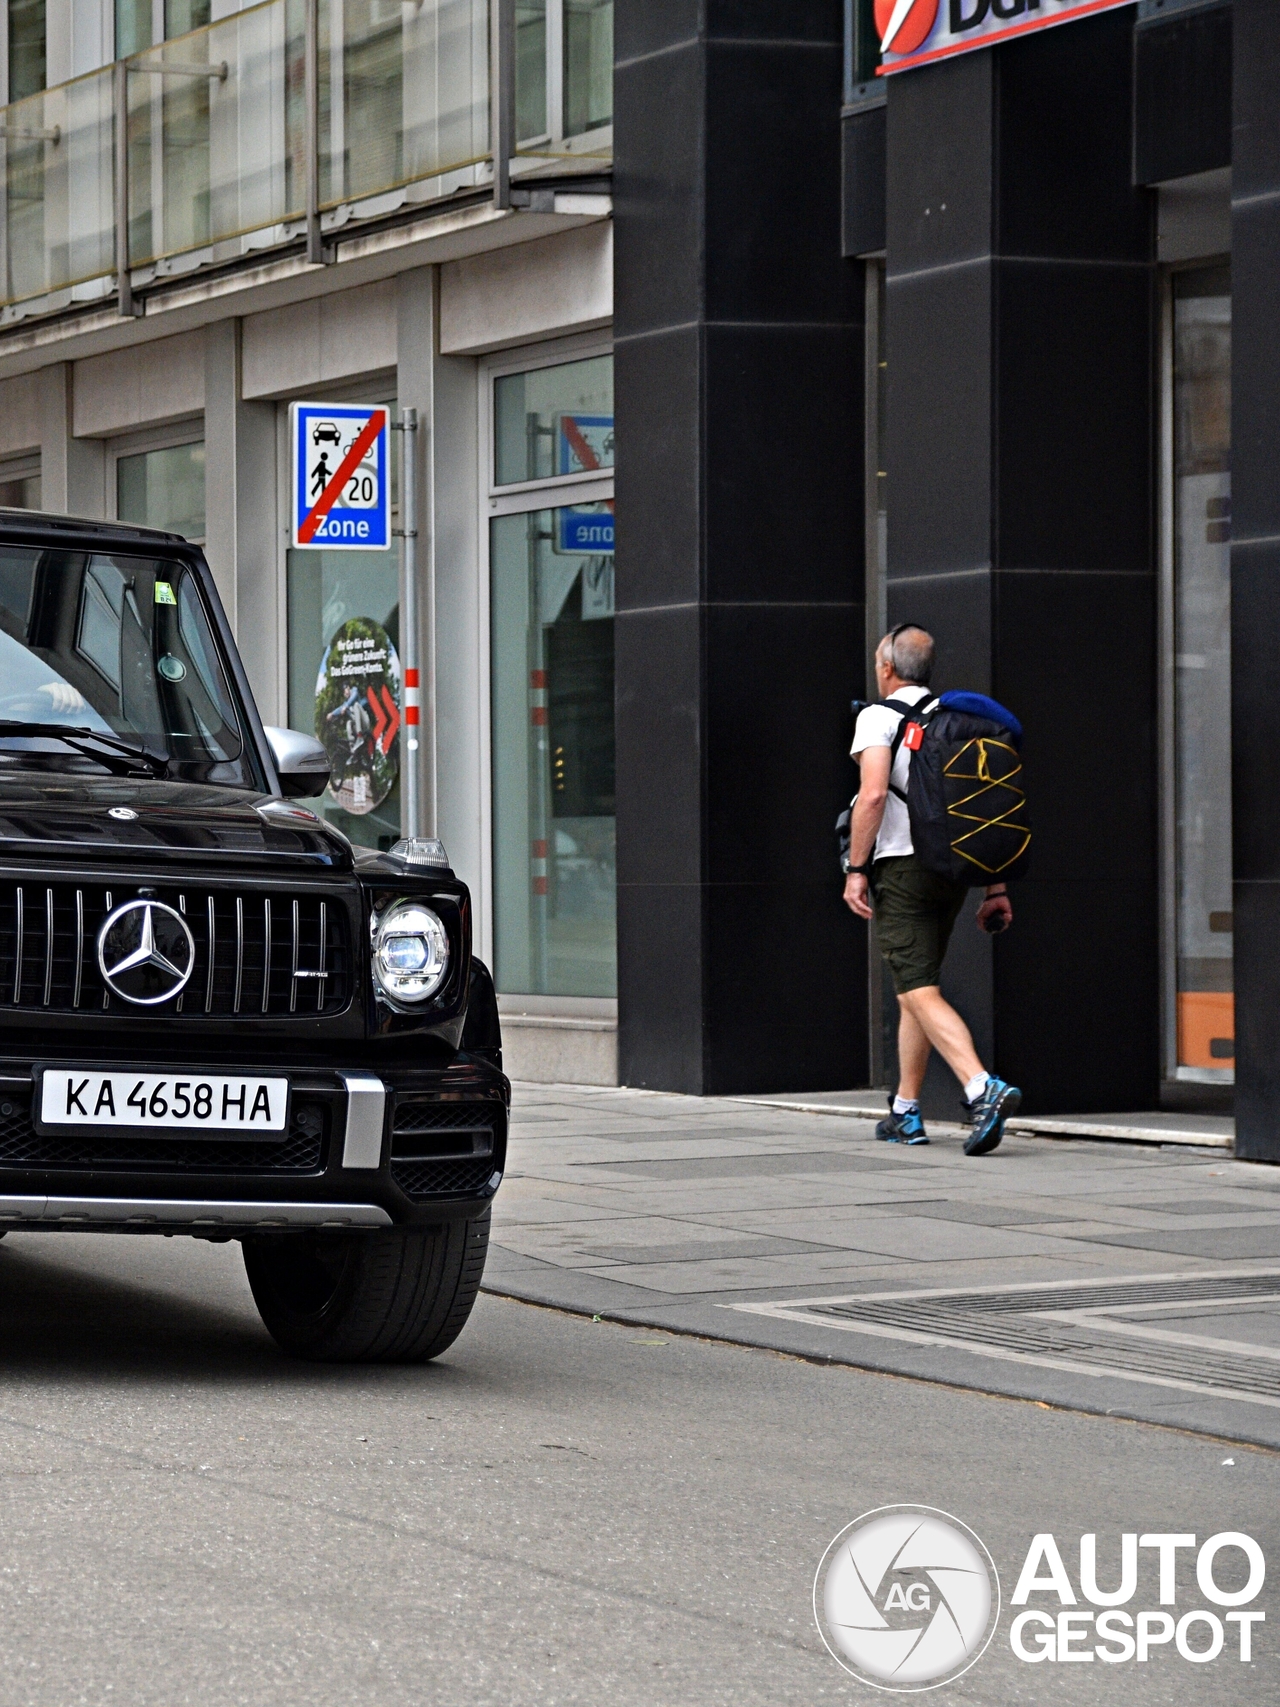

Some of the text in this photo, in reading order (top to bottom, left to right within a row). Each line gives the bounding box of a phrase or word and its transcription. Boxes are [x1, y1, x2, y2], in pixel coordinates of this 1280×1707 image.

[349, 477, 373, 501] 20
[315, 515, 370, 538] Zone
[66, 1078, 272, 1121] KA 4658 HA
